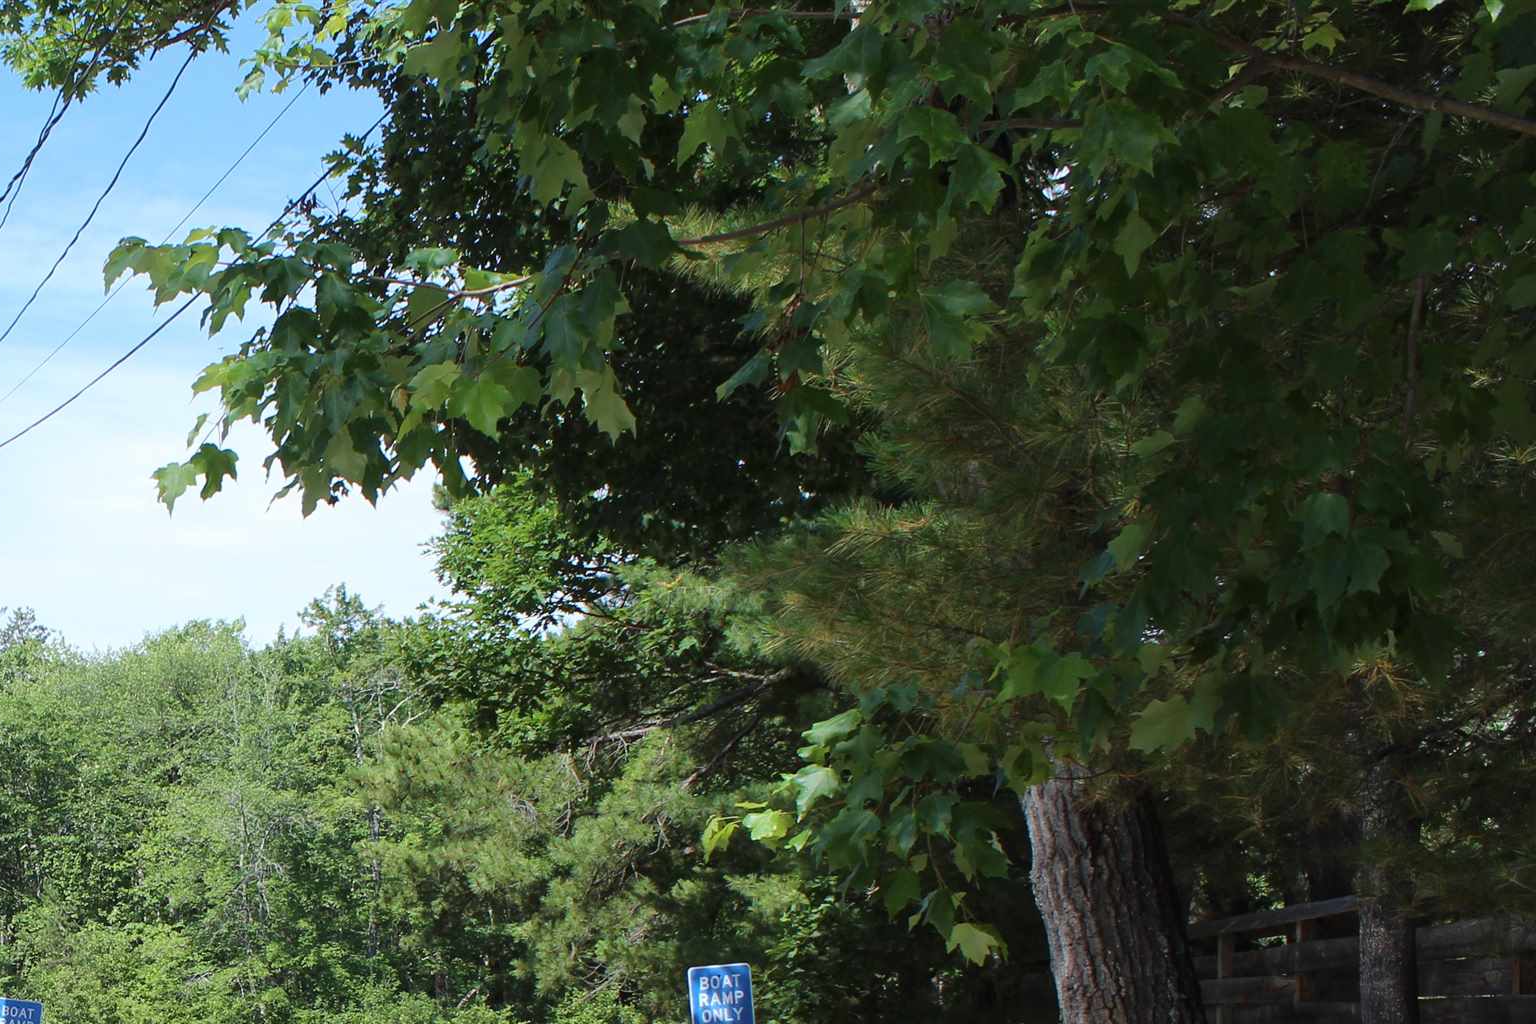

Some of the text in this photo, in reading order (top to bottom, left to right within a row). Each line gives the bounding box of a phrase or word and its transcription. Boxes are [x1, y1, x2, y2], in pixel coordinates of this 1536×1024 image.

[699, 974, 741, 991] BOAT
[698, 990, 744, 1007] RAMP
[2, 1005, 35, 1019] BOAT
[702, 1006, 744, 1023] ONLY
